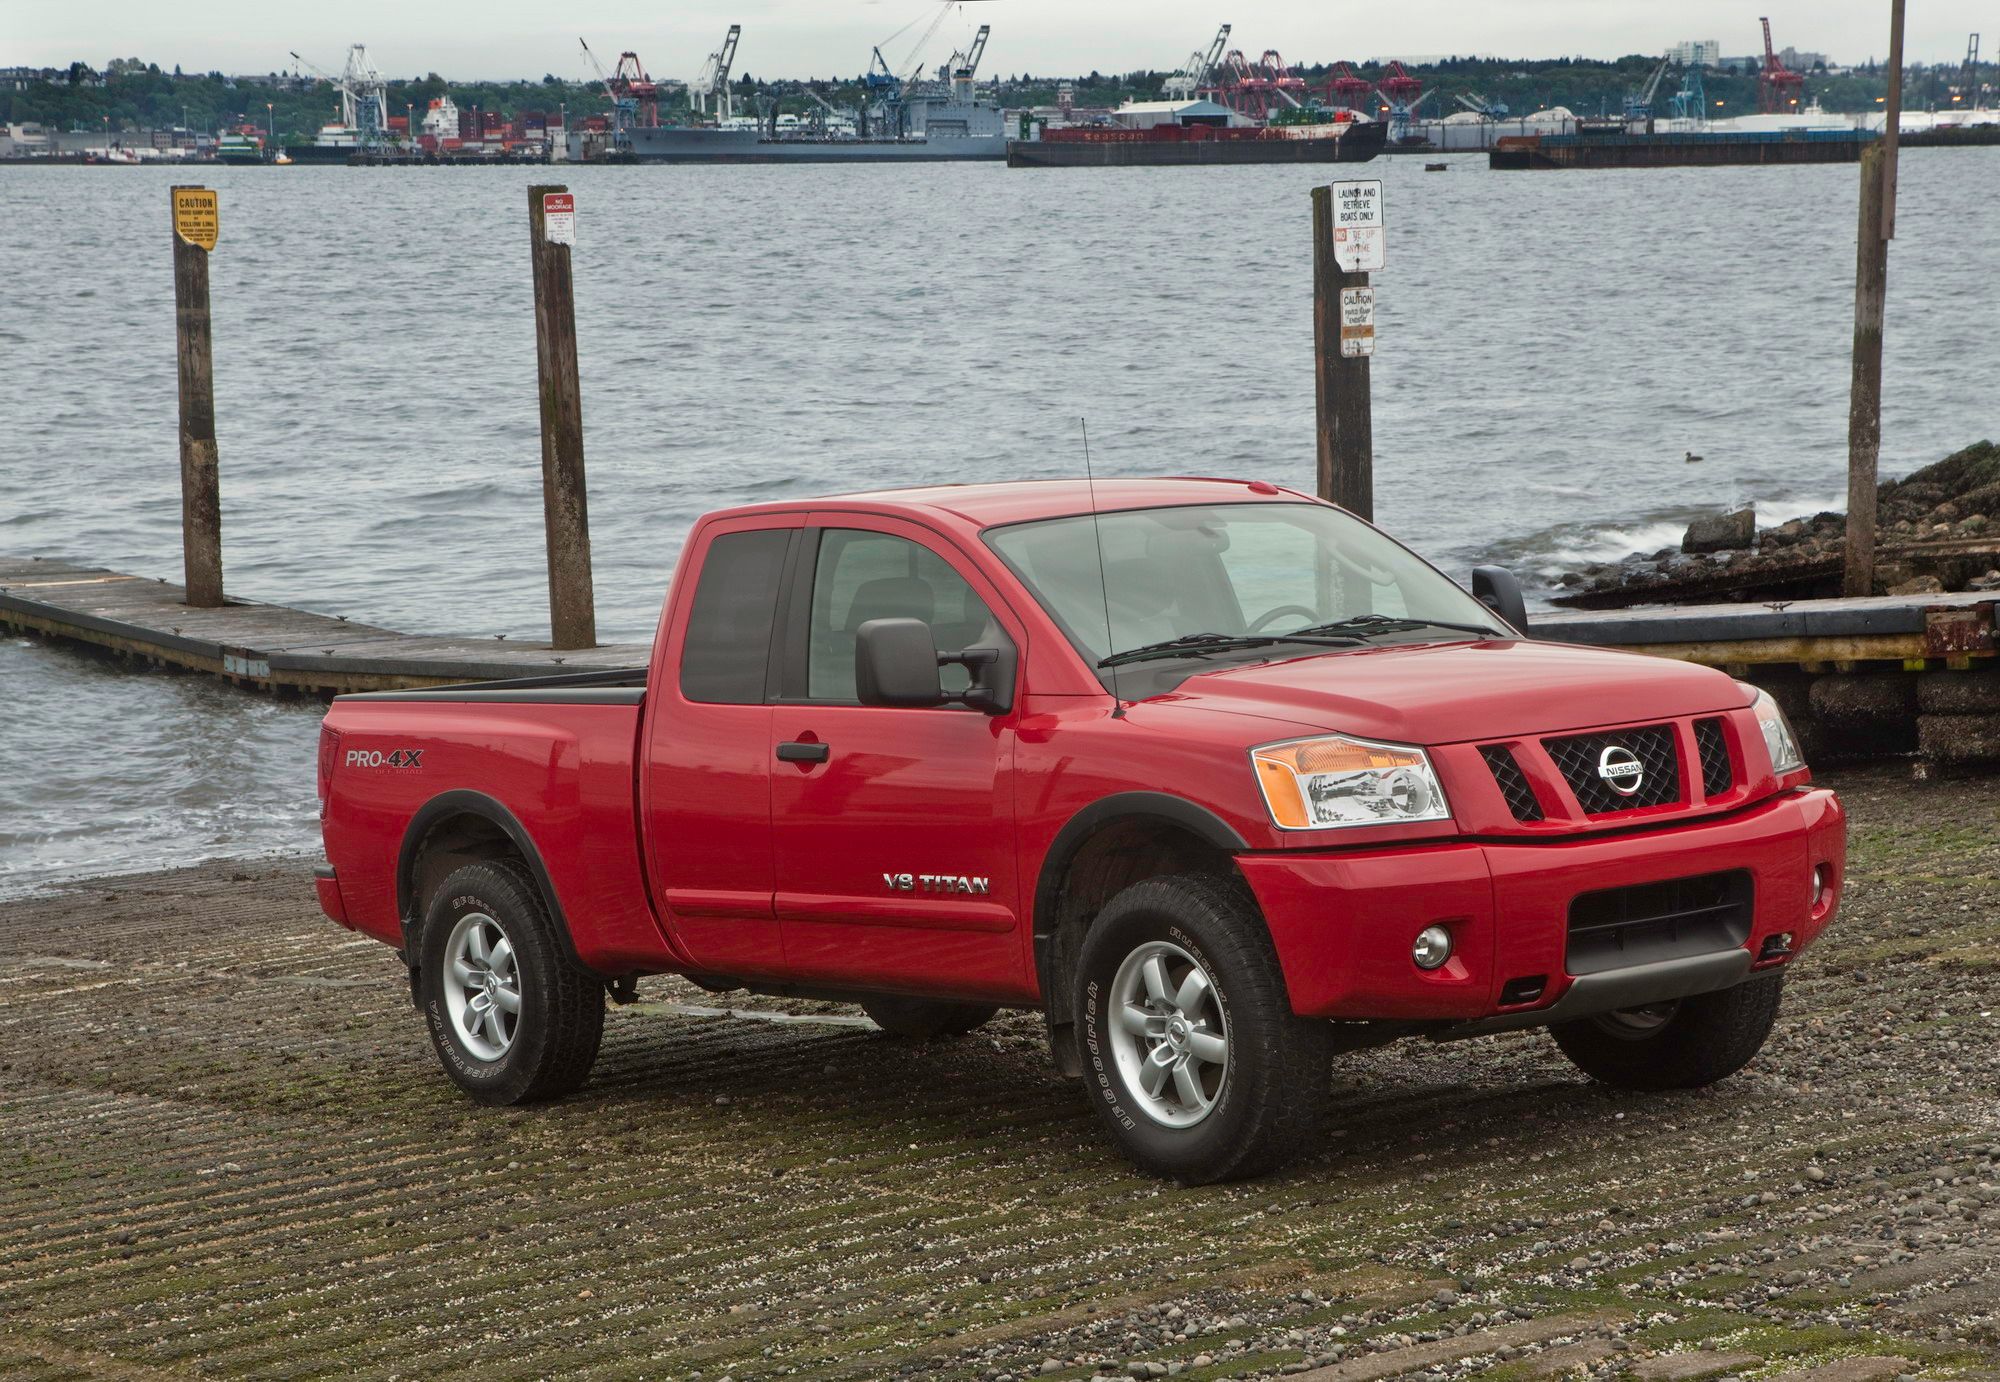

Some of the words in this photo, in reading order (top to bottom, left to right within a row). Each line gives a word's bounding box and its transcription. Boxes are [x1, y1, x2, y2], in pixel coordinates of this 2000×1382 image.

[1363, 188, 1376, 197] AND
[179, 198, 213, 208] CAUTION
[1343, 199, 1370, 209] RETRIEVE
[1340, 212, 1357, 222] BOATS
[1359, 211, 1375, 221] ONLY
[1336, 230, 1346, 240] NO
[1344, 295, 1372, 306] CAUTION
[1606, 764, 1642, 776] NISSAN
[883, 873, 914, 890] V8
[919, 874, 989, 894] TITAN
[1085, 981, 1136, 1131] BFGoodrich
